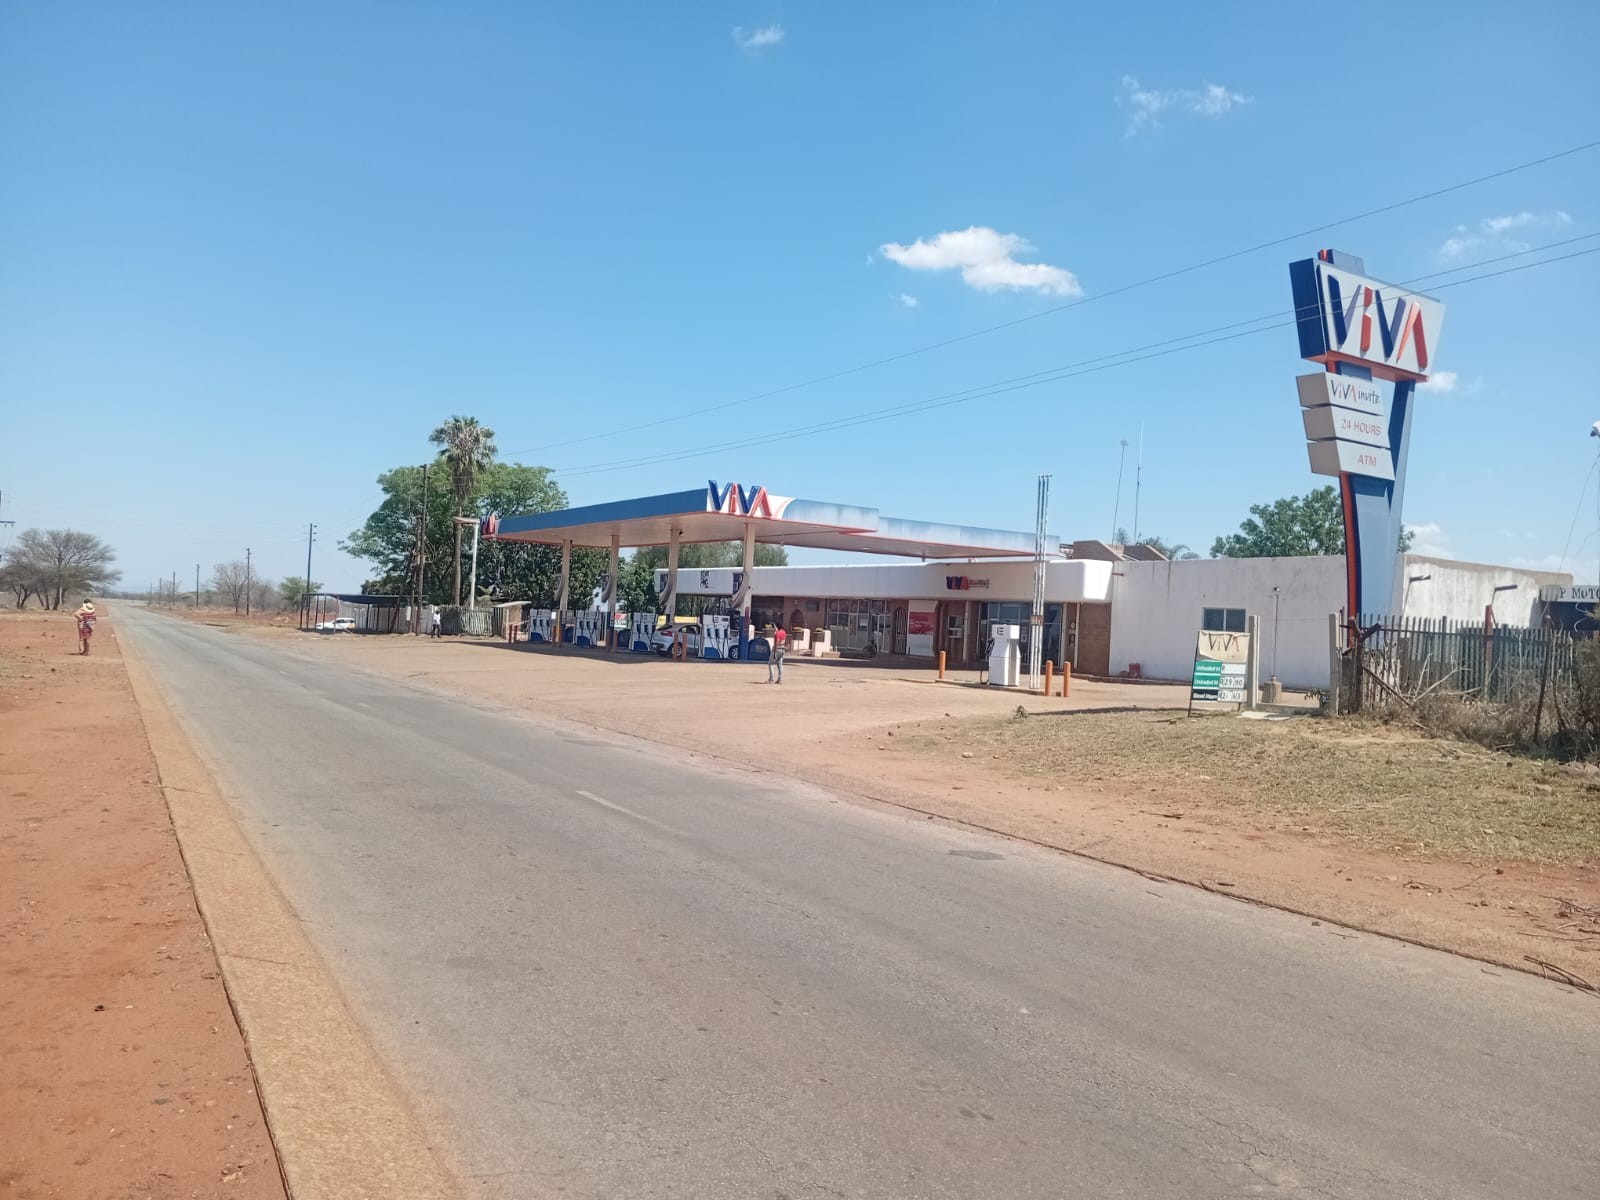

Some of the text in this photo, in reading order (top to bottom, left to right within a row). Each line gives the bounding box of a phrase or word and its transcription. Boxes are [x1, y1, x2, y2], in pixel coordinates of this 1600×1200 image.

[1342, 419, 1382, 436] 24 HOURS
[1357, 454, 1377, 467] ATM
